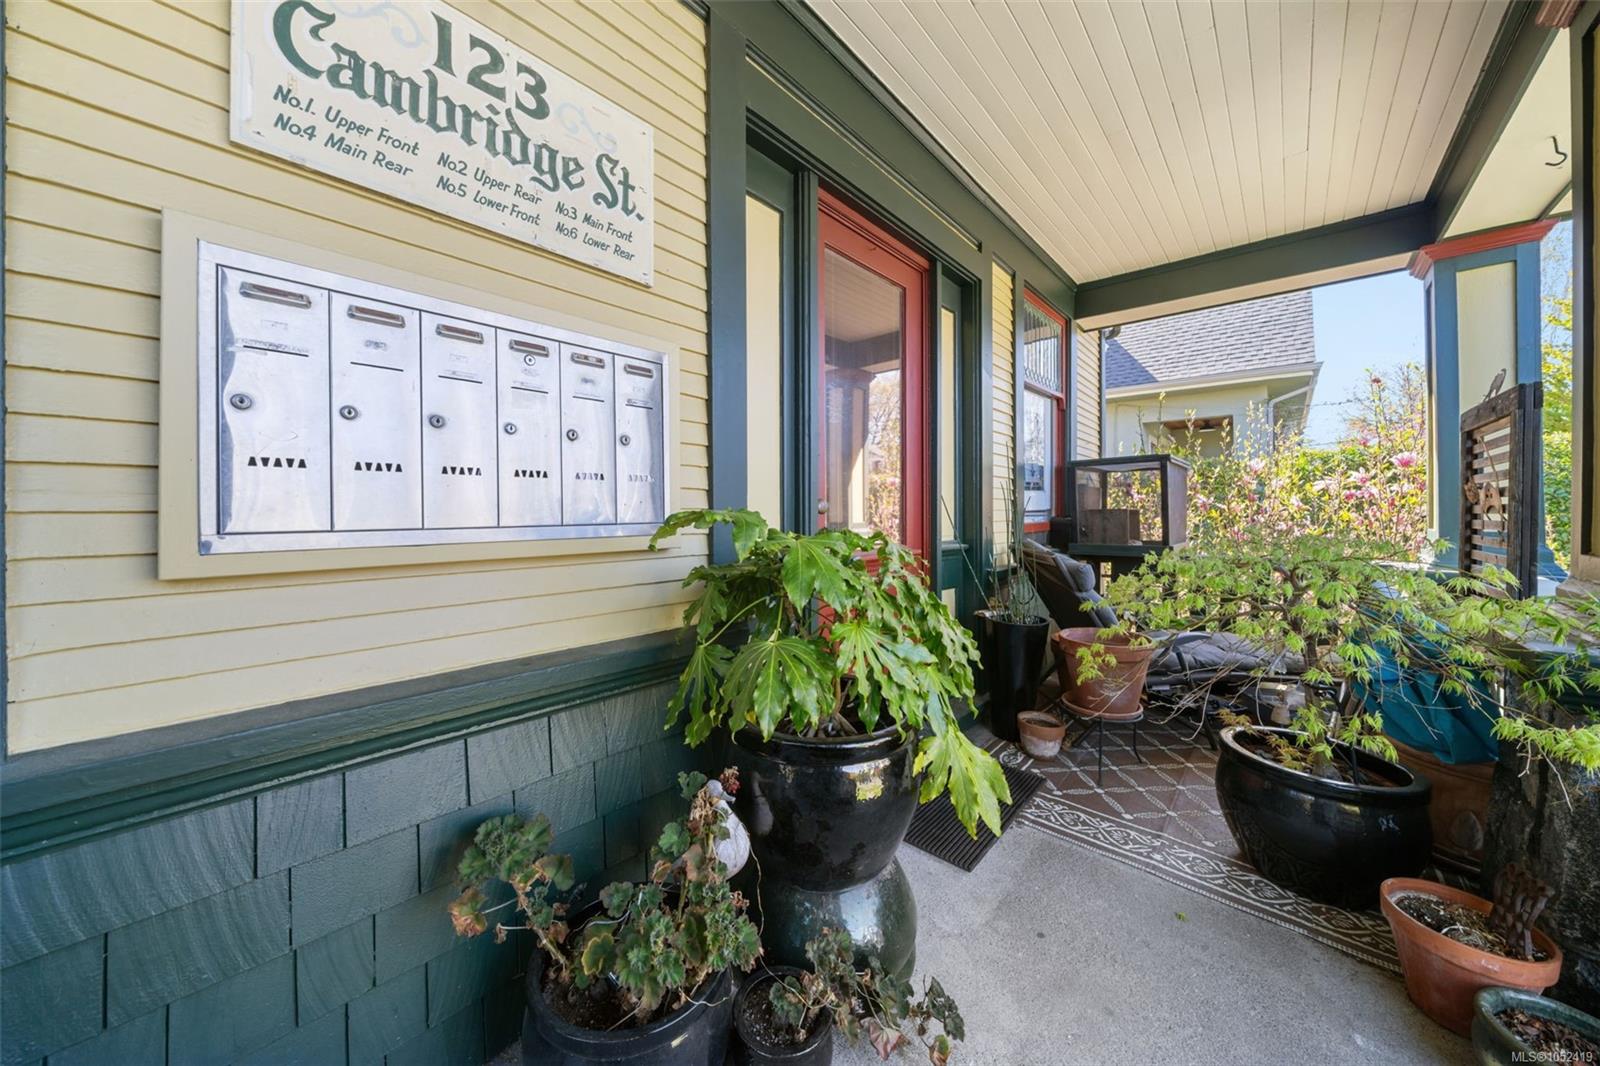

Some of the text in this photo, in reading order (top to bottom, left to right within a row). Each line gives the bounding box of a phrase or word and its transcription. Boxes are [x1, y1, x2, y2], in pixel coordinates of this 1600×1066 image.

[430, 11, 550, 120] 123
[273, 0, 645, 222] Cambridge St.
[325, 106, 374, 137] Upper
[377, 127, 421, 156] Front
[273, 113, 414, 176] No.4 Main Rear
[436, 175, 541, 226] No.5 Lower Front
[474, 167, 510, 192] Upper
[514, 184, 543, 205] Rear
[583, 212, 604, 232] Main
[606, 223, 633, 243] Front
[583, 233, 611, 251] Lower
[613, 243, 635, 262] Rear
